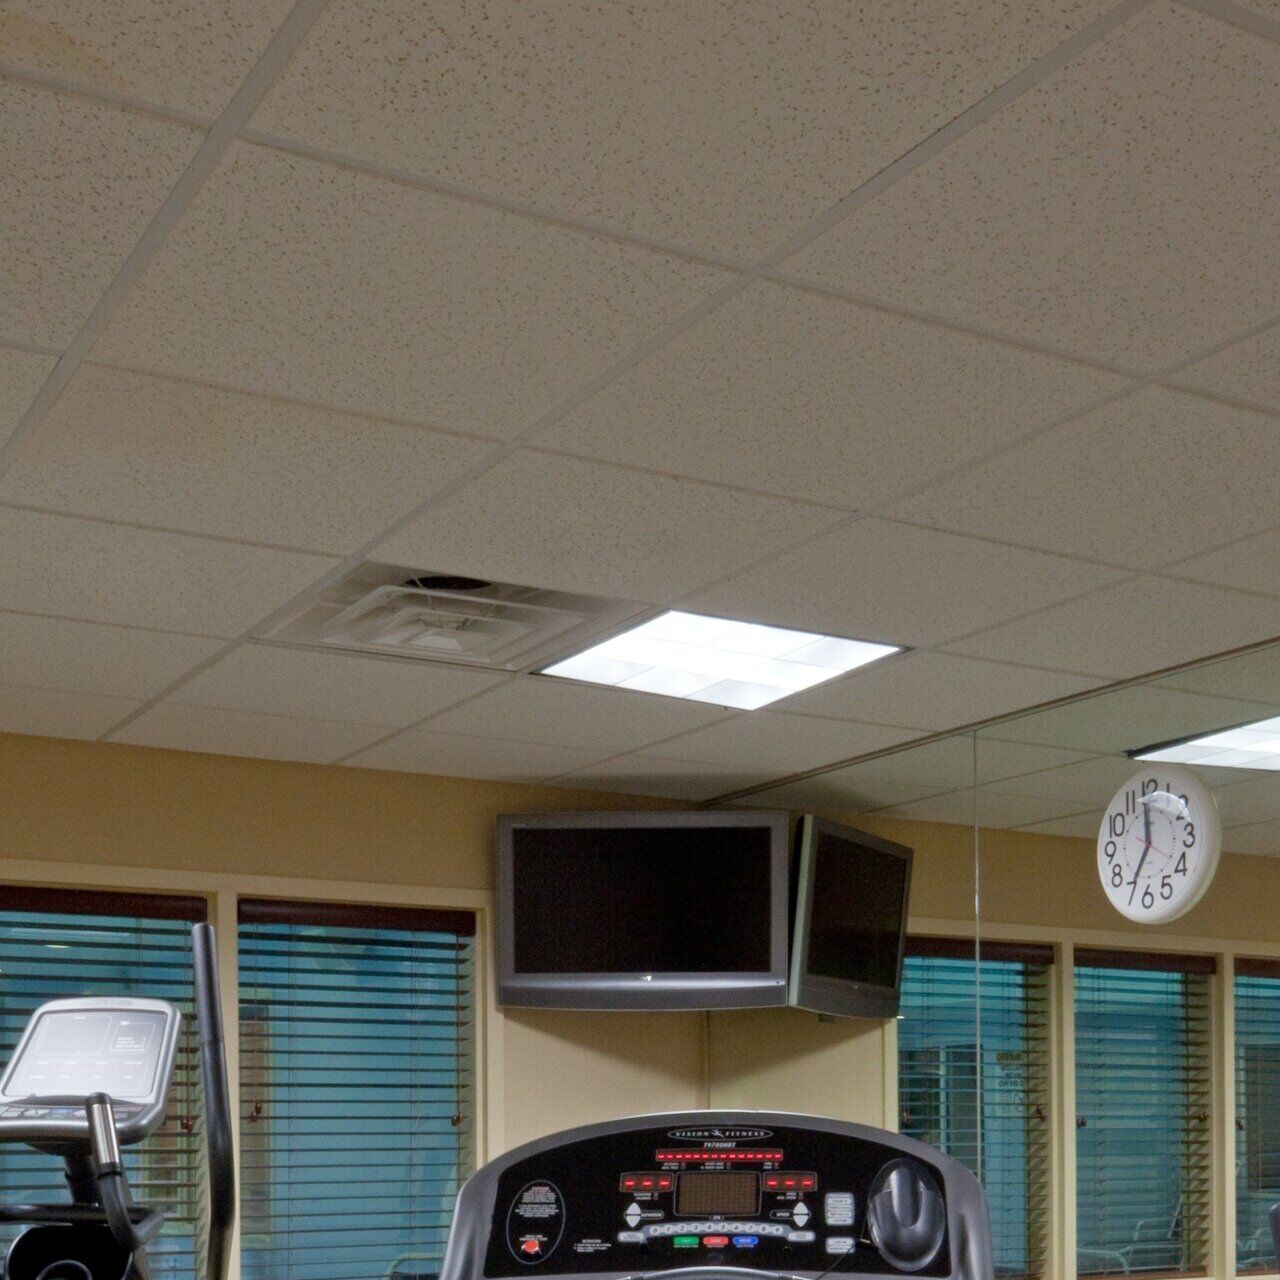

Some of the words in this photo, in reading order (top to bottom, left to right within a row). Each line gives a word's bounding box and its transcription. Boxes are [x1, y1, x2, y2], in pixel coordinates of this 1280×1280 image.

[1126, 790, 1136, 815] 11
[1109, 813, 1126, 838] 10
[1183, 823, 1196, 848] 3
[1104, 841, 1117, 865] 9
[1174, 852, 1188, 876] 4
[1111, 864, 1123, 888] 8
[1160, 875, 1173, 900] 5
[1126, 880, 1137, 906] 7
[1141, 884, 1154, 909] 6
